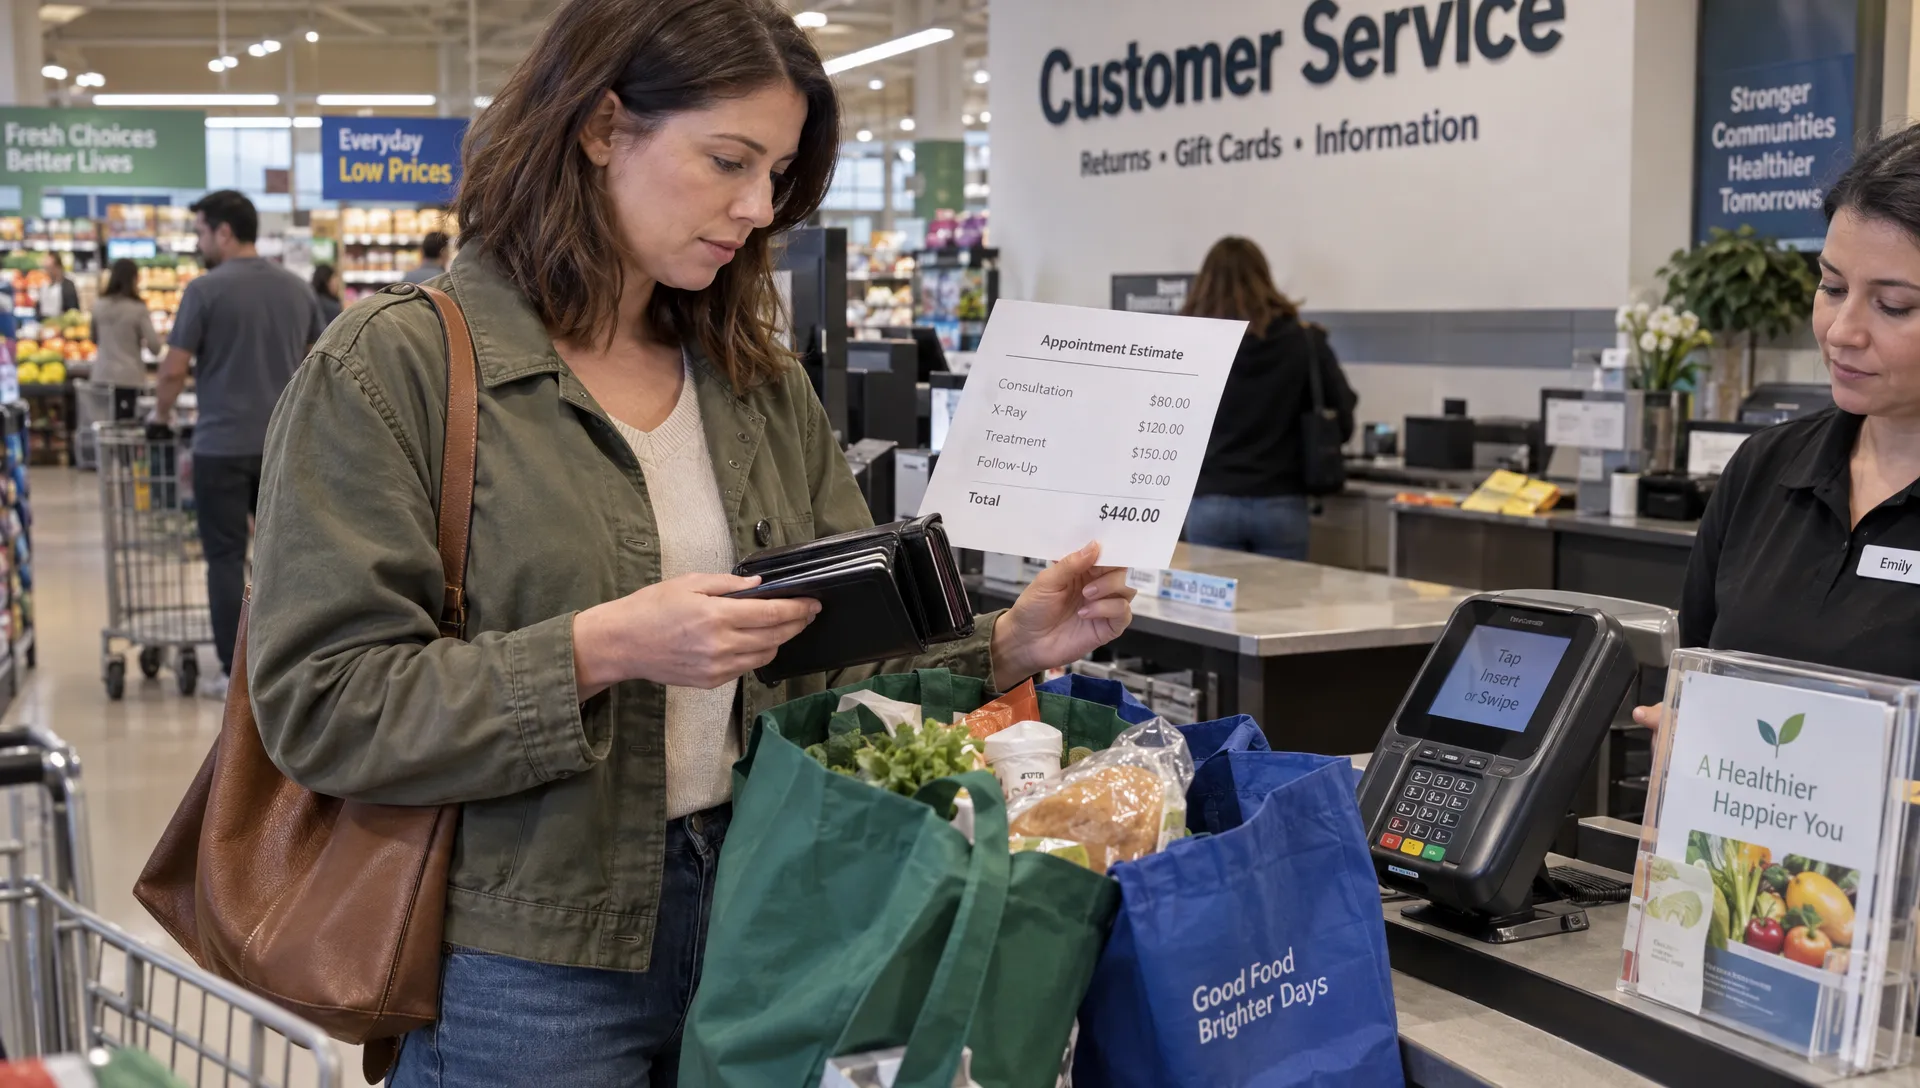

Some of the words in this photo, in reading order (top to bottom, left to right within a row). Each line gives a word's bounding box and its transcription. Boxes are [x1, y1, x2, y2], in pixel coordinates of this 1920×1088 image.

[1039, 30, 1283, 125] Customer
[1301, 0, 1566, 85] Service
[1731, 82, 1812, 113] Stronger
[4, 122, 64, 146] Fresh
[70, 123, 156, 148] Choices
[339, 128, 423, 156] Everyday
[1081, 149, 1151, 177] Returns
[1175, 135, 1212, 168] Gift
[1219, 128, 1282, 161] Cards
[1315, 110, 1478, 155] Information
[1712, 112, 1836, 149] Communities
[6, 148, 73, 172] Better
[78, 150, 133, 173] Lives
[339, 157, 383, 183] Low
[388, 157, 451, 184] Prices
[1728, 151, 1814, 181] Healthier
[1719, 187, 1822, 214] Tomorrows
[1041, 335, 1127, 355] Appointment
[1130, 344, 1184, 360] Estimate
[998, 378, 1073, 398] Consultation
[1149, 394, 1190, 409] $80.00
[991, 404, 1027, 420] X-Ray
[1138, 420, 1184, 436] $120.00
[986, 430, 1046, 448] Treatment
[1132, 446, 1178, 461] $150.00
[977, 456, 1038, 475] Follow-Up
[1130, 472, 1170, 487] $90.00
[968, 491, 1000, 507] Total
[1099, 504, 1160, 523] $440.00
[1880, 557, 1912, 575] Emily
[1498, 649, 1522, 667] Tap
[1480, 668, 1520, 688] Insert
[1464, 691, 1477, 701] or
[1478, 690, 1519, 711] Swipe
[1696, 755, 1711, 778] A
[1718, 759, 1817, 801] Healthier
[1713, 791, 1797, 830] Happier
[1803, 811, 1844, 842] You
[1193, 968, 1246, 1013] Good
[1250, 946, 1295, 989] Food
[1198, 994, 1275, 1045] Brighter
[1280, 976, 1328, 1008] Days
